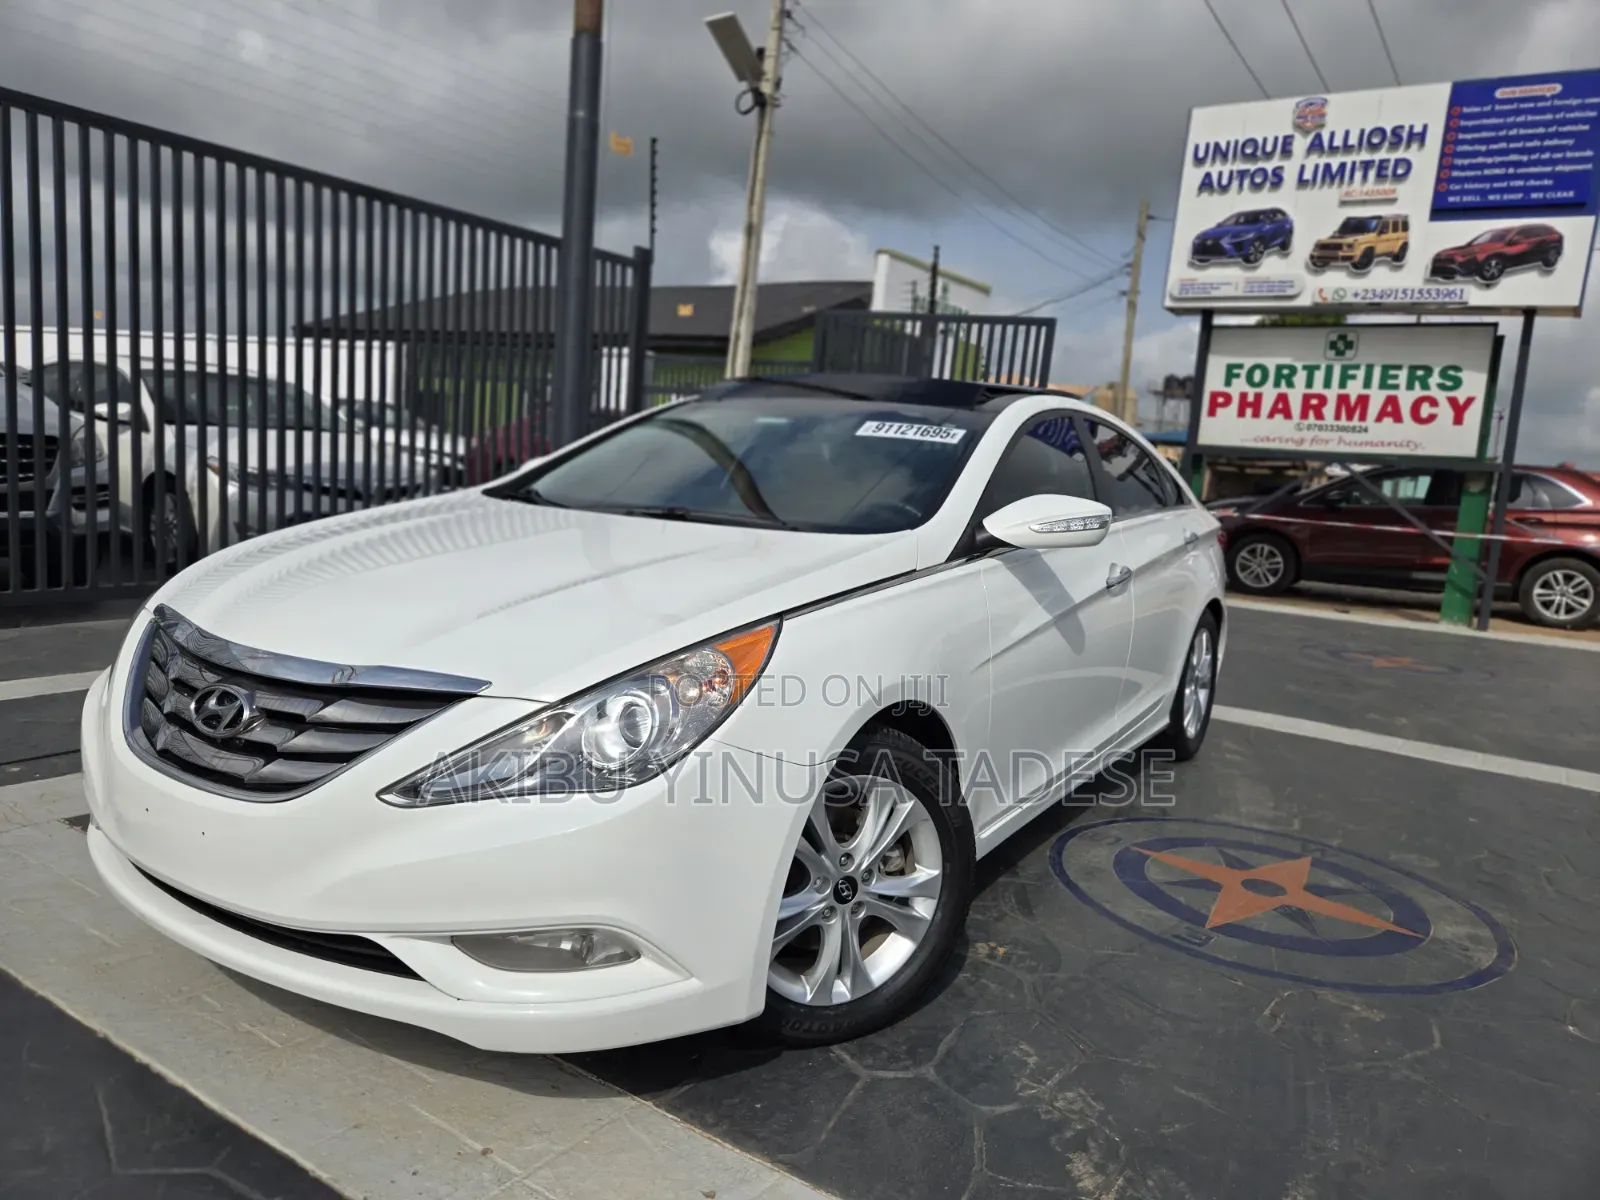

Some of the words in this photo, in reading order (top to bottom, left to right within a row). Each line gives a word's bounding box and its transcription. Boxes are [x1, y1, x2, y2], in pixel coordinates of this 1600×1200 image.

[1192, 134, 1295, 165] UNIQUE
[1305, 123, 1429, 156] ALLIOSH
[1197, 166, 1284, 194] AUTOS
[1297, 157, 1413, 187] LIMITED
[1352, 287, 1465, 301] +2349151553961
[1223, 362, 1463, 392] FORTIFIERS
[1206, 390, 1477, 426] PHARMACY
[1308, 434, 1333, 447] for
